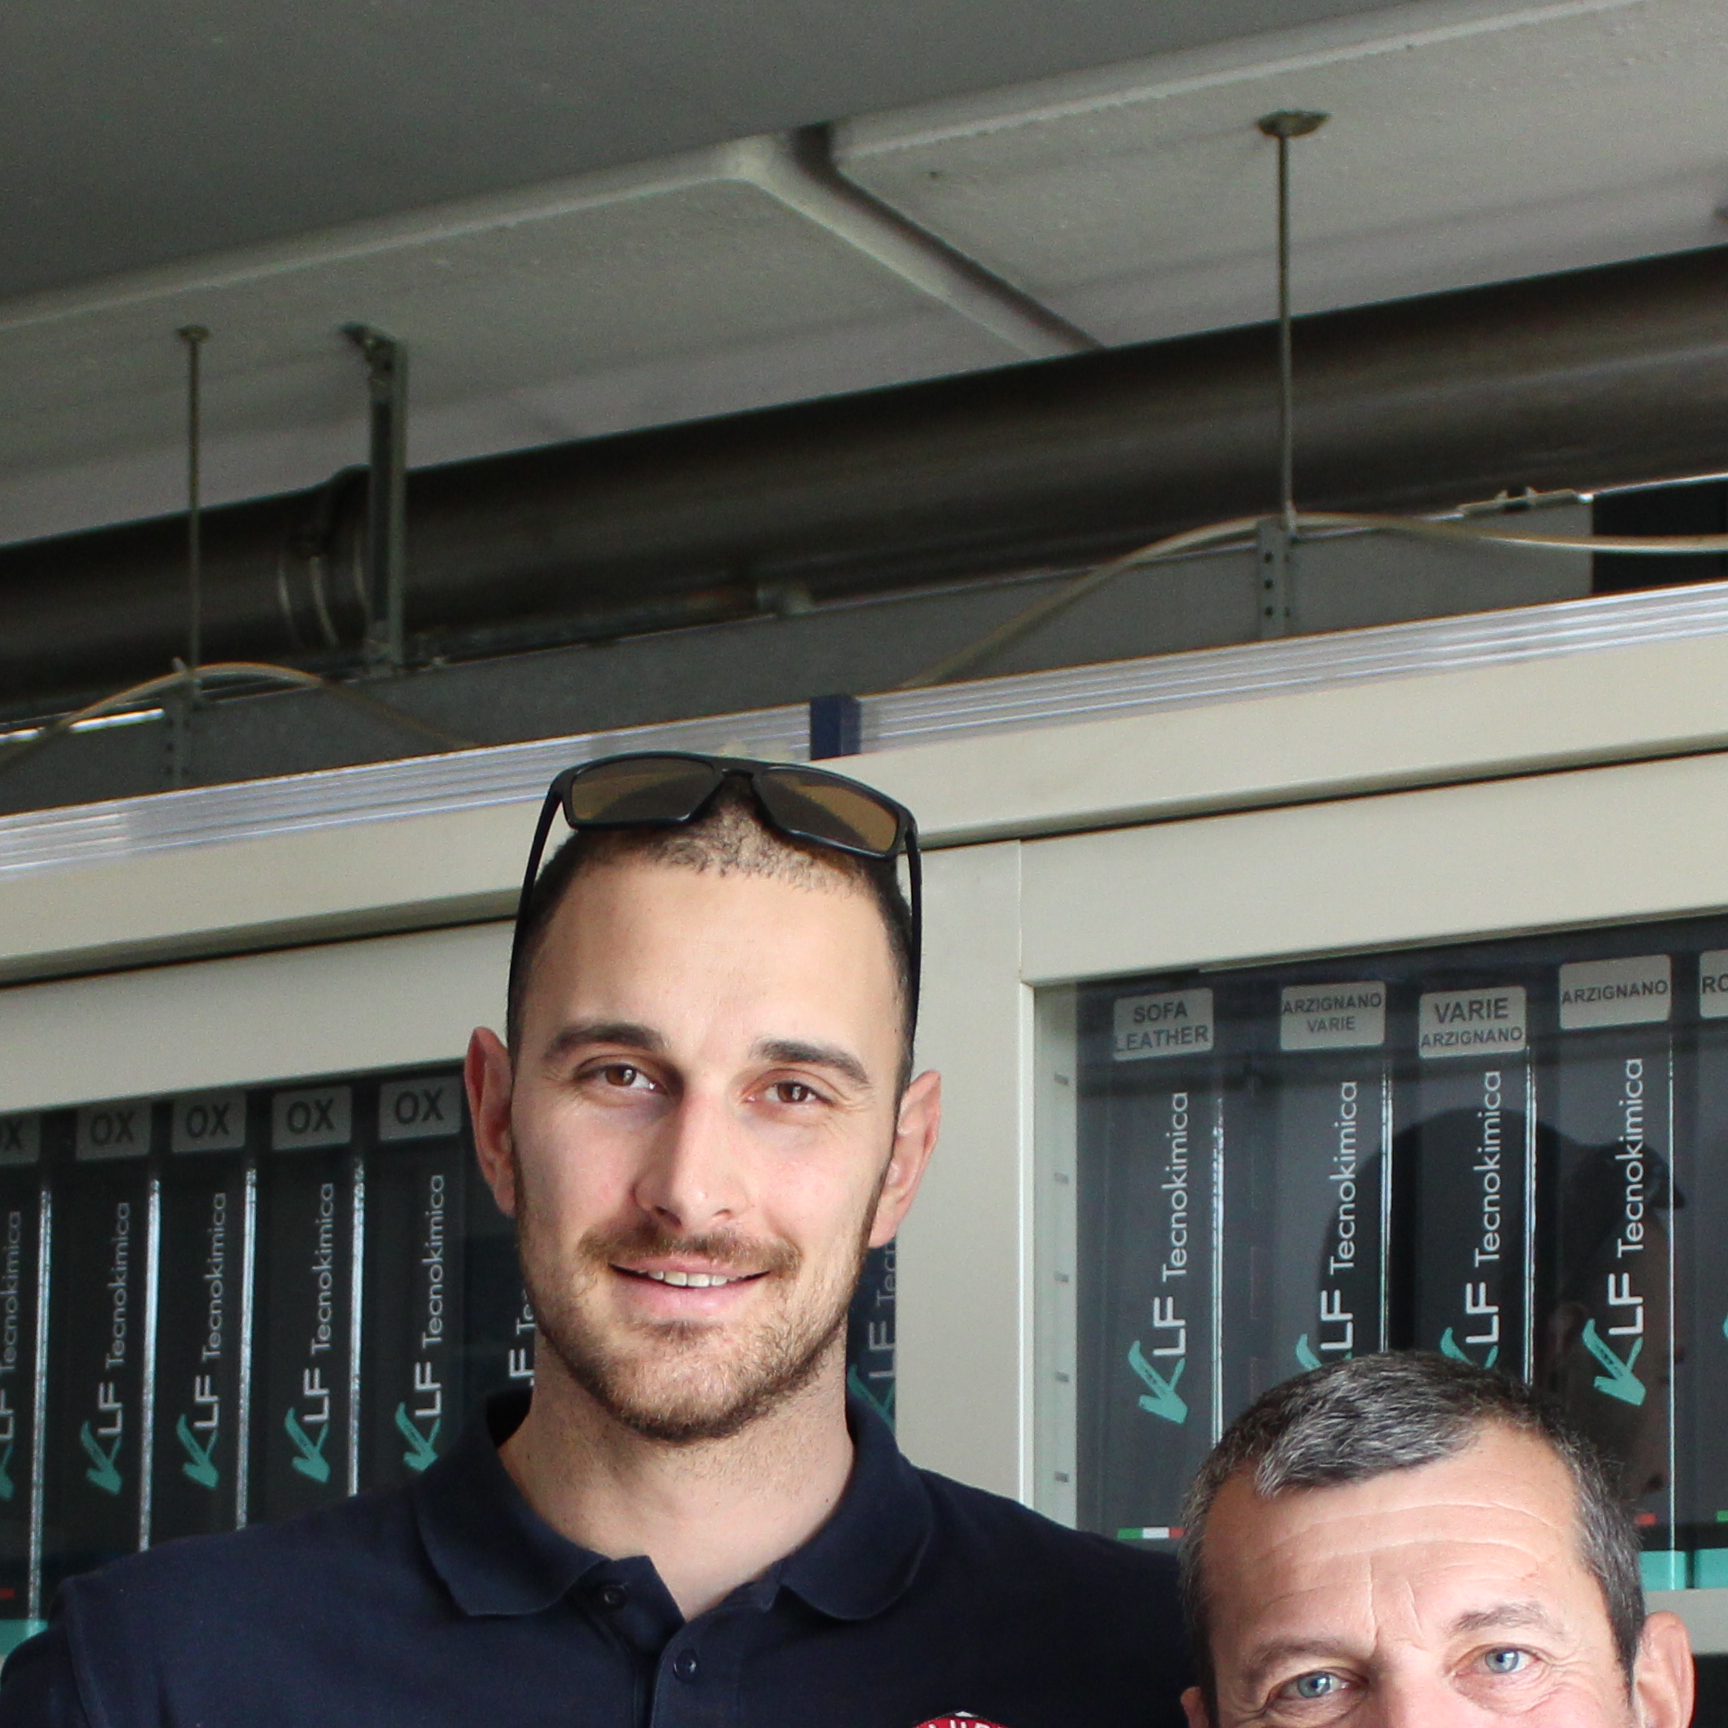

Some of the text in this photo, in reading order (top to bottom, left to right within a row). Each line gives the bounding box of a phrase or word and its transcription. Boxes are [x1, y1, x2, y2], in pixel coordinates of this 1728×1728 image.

[1281, 990, 1382, 1016] ARZIGNANO
[1560, 979, 1668, 1005] ARZIGNANO
[1133, 1000, 1188, 1023] SOFA
[1306, 1015, 1357, 1033] VARIE
[1434, 997, 1510, 1024] VARIE
[1114, 1025, 1209, 1053] LEATHER
[1420, 1026, 1523, 1049] ARZIGNANO
[186, 1103, 230, 1138] OX
[287, 1100, 334, 1134] OX
[394, 1089, 444, 1125] OX
[90, 1111, 134, 1145] OX
[1465, 1070, 1501, 1345] LF Tecnokimica
[1608, 1057, 1645, 1337] LF Tecnokimica
[1153, 1091, 1189, 1357] LF Tecnokimica
[1321, 1080, 1358, 1351] LF Tecnokimica
[193, 1191, 227, 1431] LF Tecnokimica
[302, 1182, 335, 1425] LF Tecnokimica
[414, 1174, 445, 1419] LF Tecnokimica
[97, 1201, 131, 1437] LF Tecnokimica
